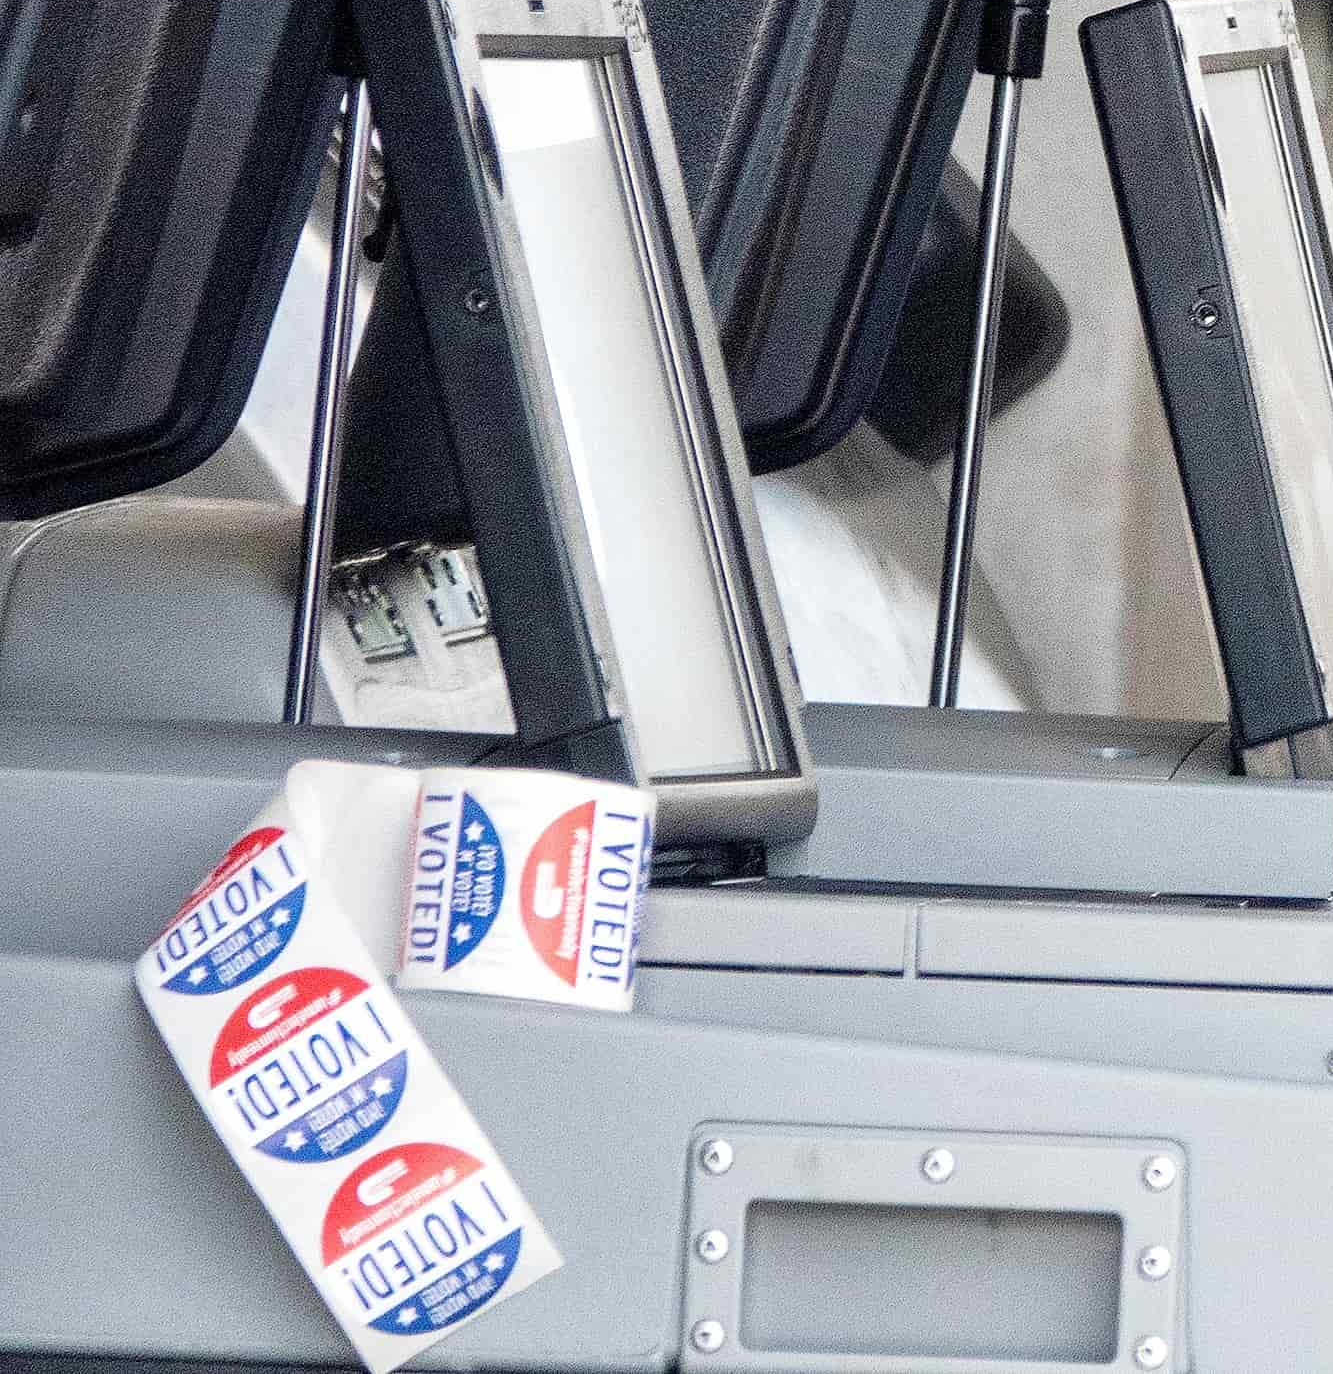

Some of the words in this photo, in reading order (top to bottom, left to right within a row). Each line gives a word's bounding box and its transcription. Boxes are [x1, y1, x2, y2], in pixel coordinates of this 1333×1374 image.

[424, 794, 454, 803] I
[604, 811, 638, 822] I
[277, 844, 295, 877] I
[408, 821, 451, 964] VOTED!
[156, 865, 273, 973] VOTED!
[586, 842, 636, 983] VOTED!
[365, 1001, 393, 1044] I
[227, 1020, 371, 1131] VOTED!
[480, 1180, 508, 1222] I
[341, 1199, 486, 1310] VOTED!
